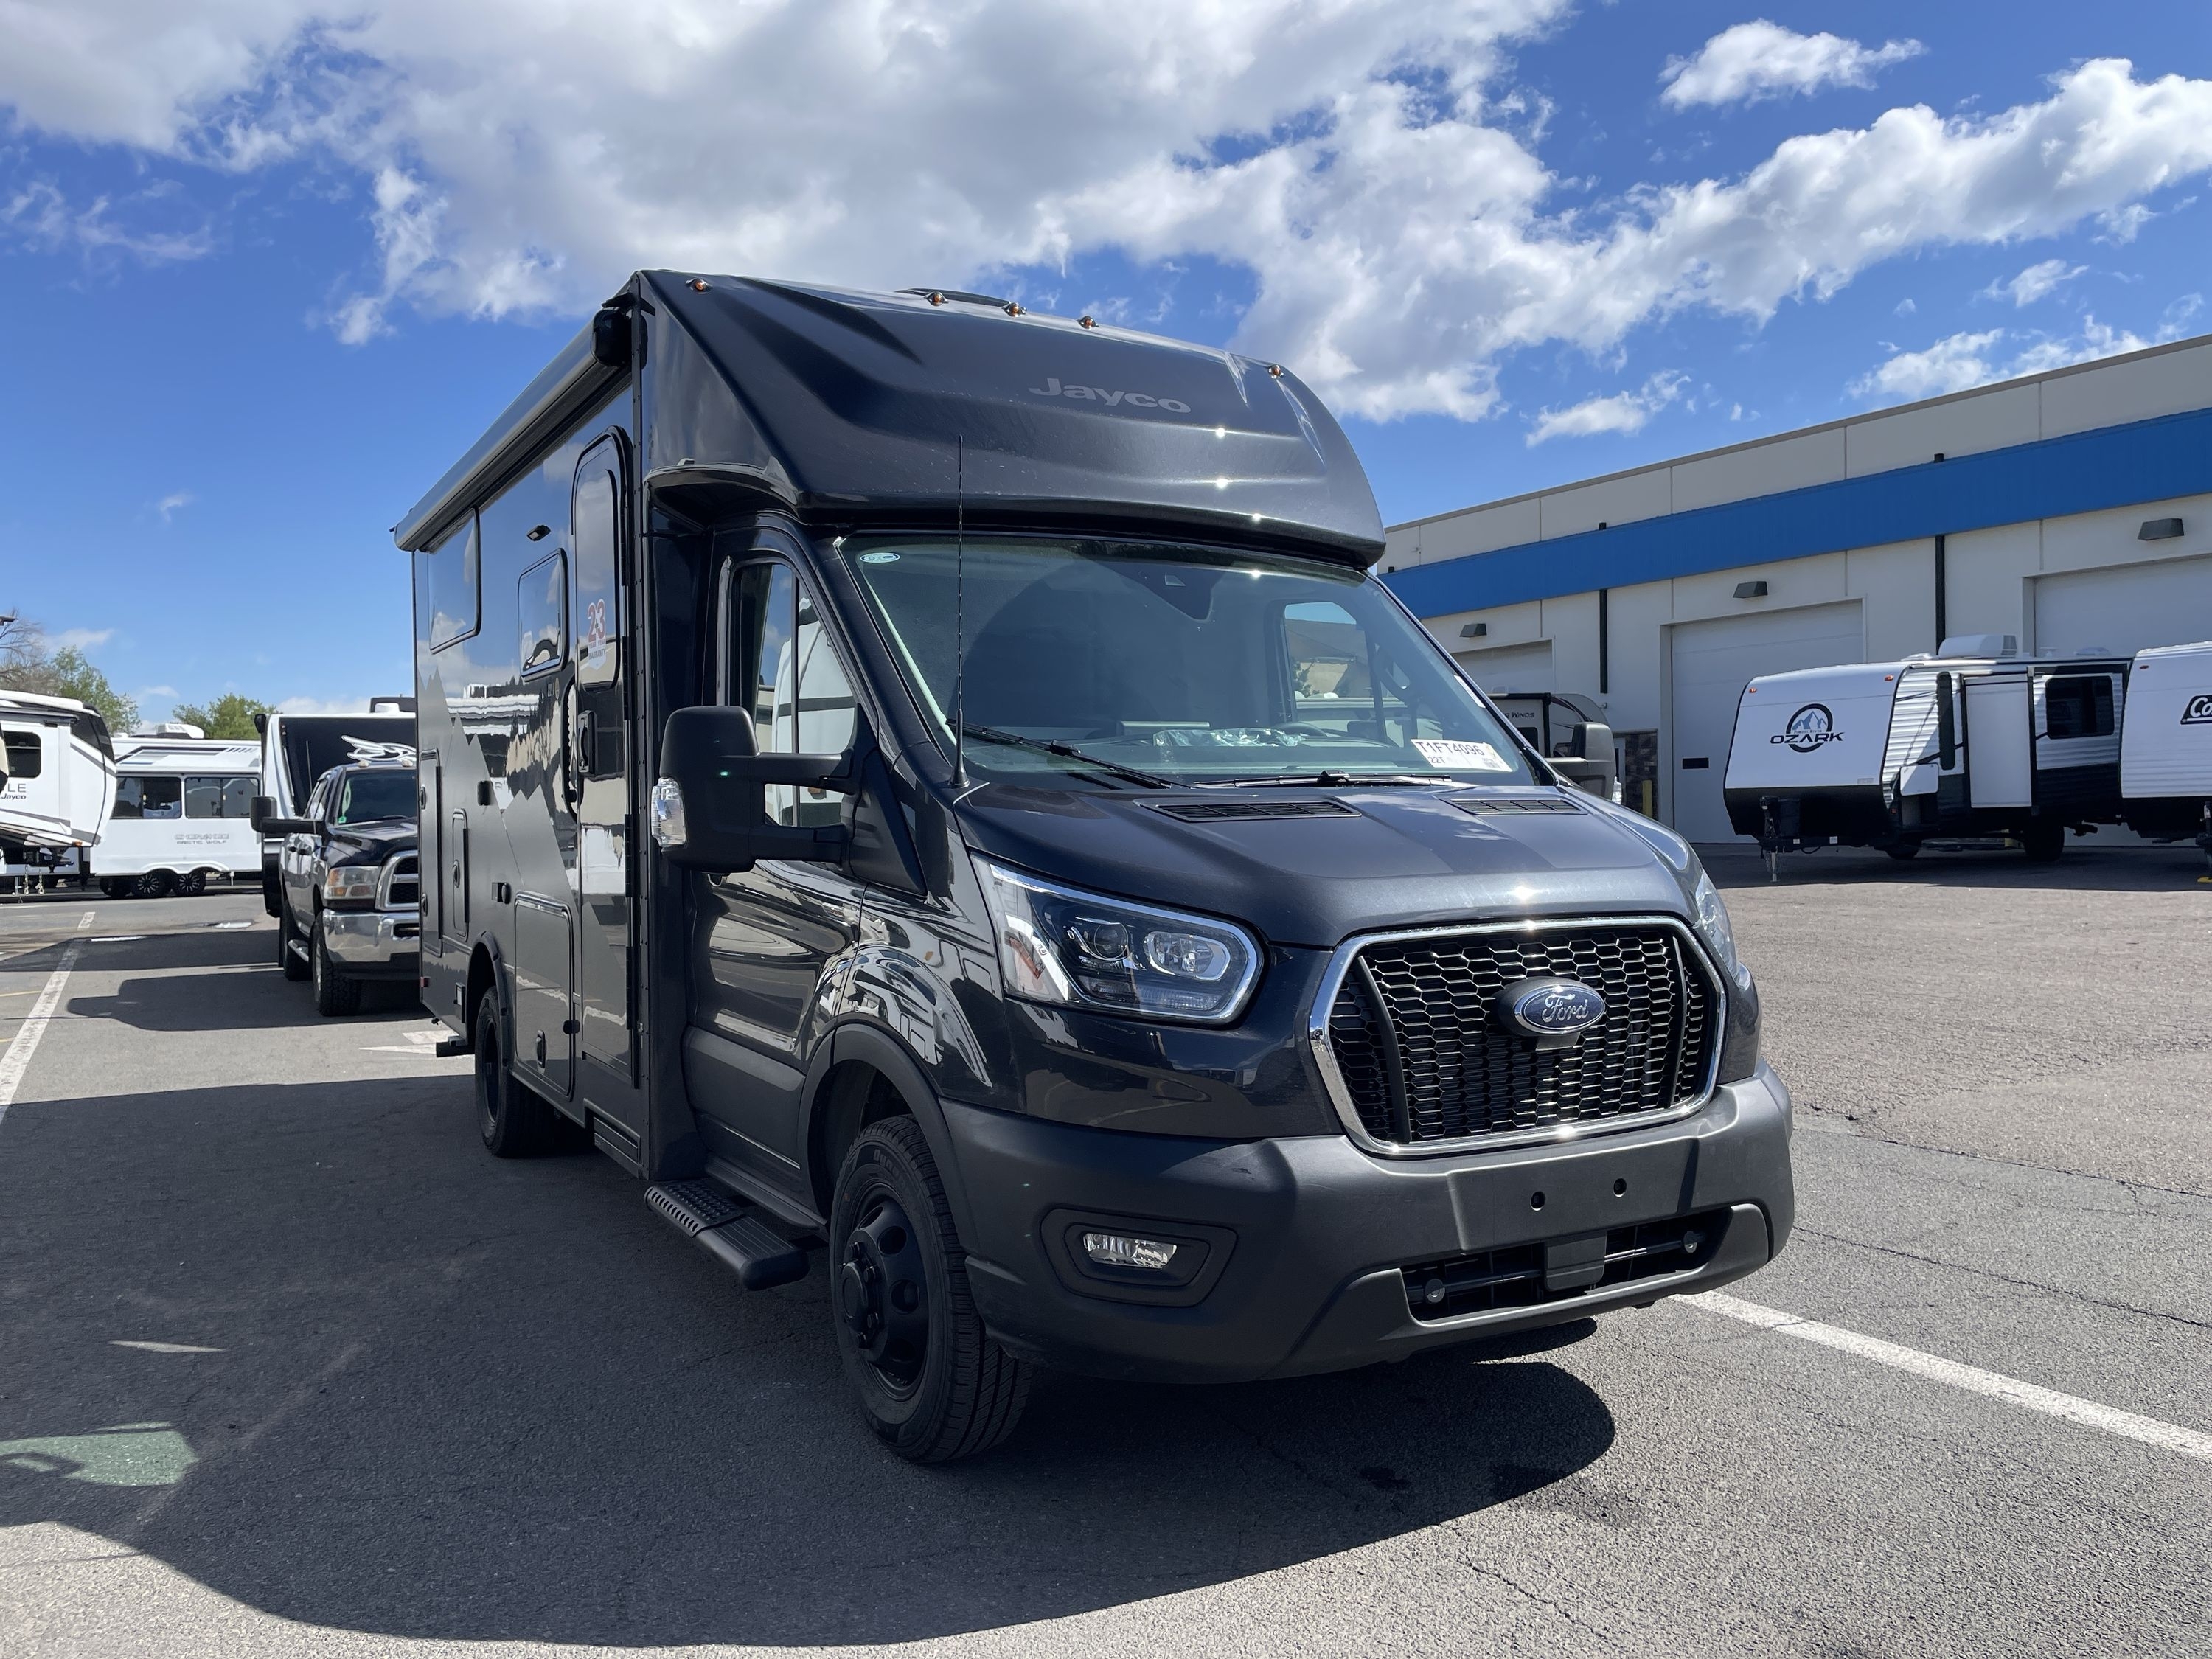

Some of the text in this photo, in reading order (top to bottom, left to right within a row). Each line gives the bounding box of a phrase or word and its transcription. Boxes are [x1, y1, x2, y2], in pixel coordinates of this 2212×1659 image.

[1028, 378, 1192, 414] Jayco
[1415, 742, 1485, 756] T1FT4096
[1770, 732, 1845, 744] OZARK
[1541, 993, 1590, 1023] Ford
